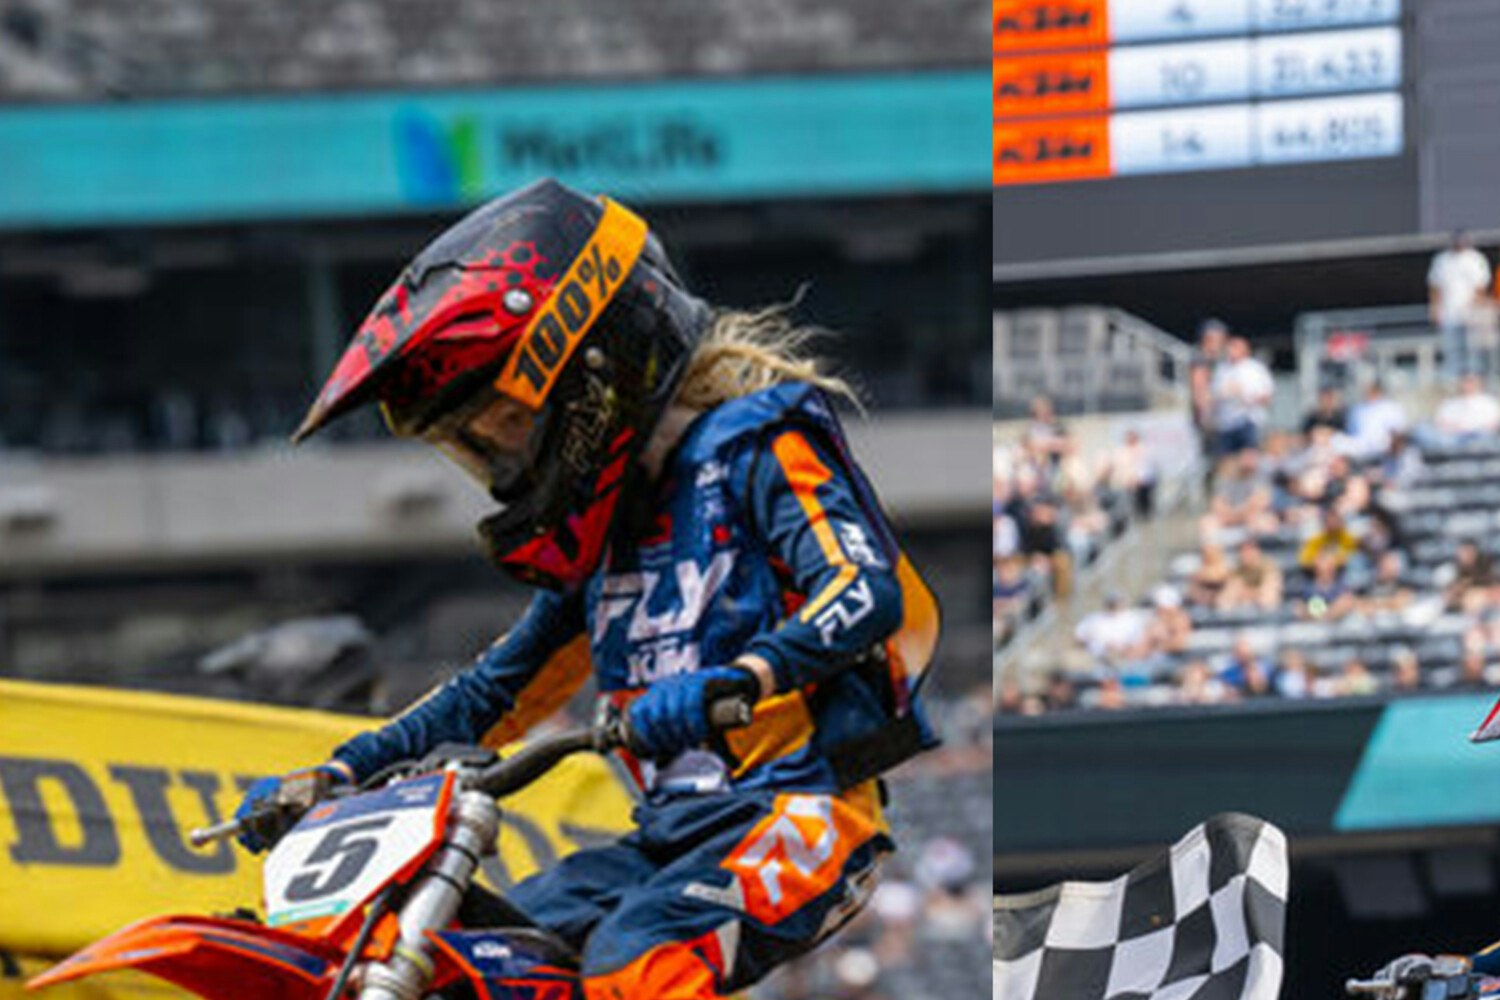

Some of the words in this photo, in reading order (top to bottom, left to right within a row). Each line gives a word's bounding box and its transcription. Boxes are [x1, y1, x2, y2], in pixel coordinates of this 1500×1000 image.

[511, 244, 622, 393] 100%
[593, 551, 740, 647] FLY
[815, 579, 876, 648] FLY
[625, 636, 700, 685] KTM
[284, 816, 395, 903] 5
